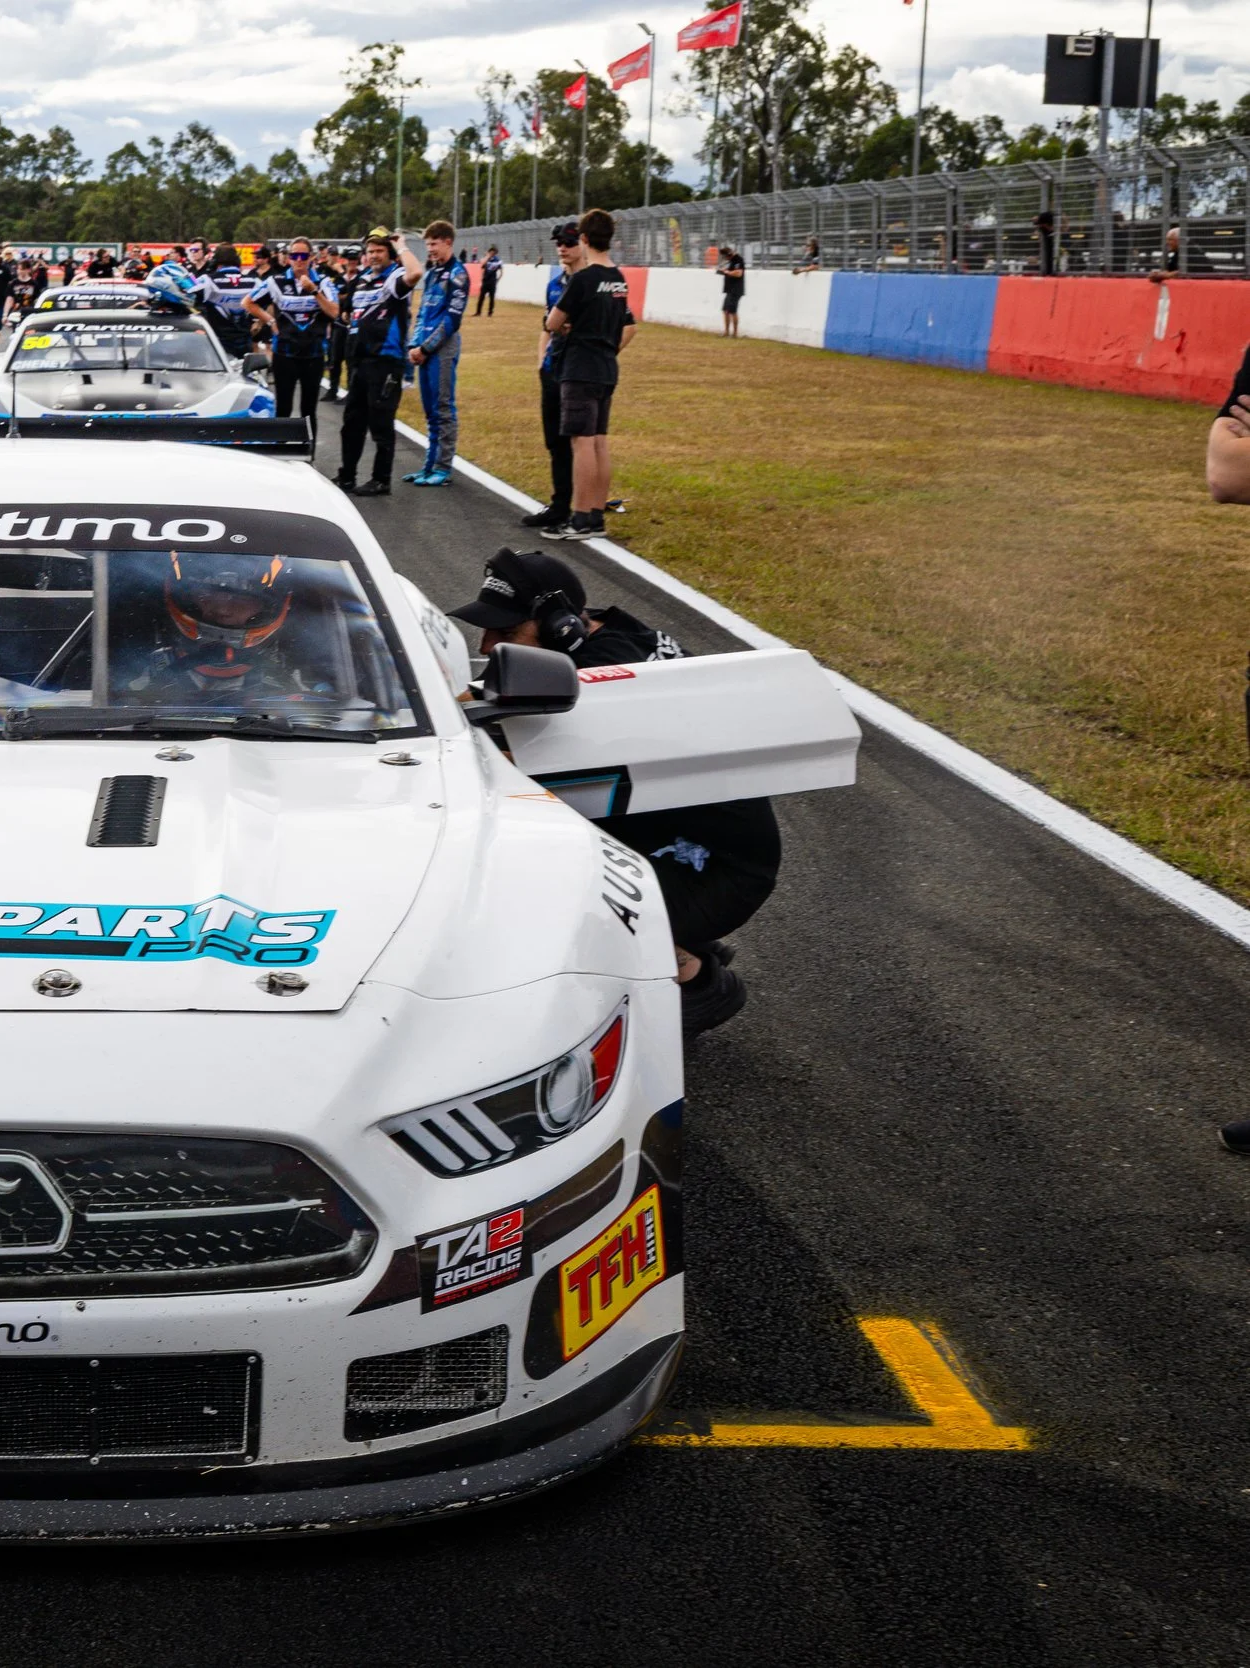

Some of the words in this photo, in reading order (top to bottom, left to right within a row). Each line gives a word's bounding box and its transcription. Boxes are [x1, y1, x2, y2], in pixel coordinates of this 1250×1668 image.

[21, 336, 51, 350] 50
[138, 935, 310, 963] PRO
[421, 1208, 524, 1271] TA2
[435, 1247, 523, 1290] RACING
[568, 1209, 648, 1327] TFH
